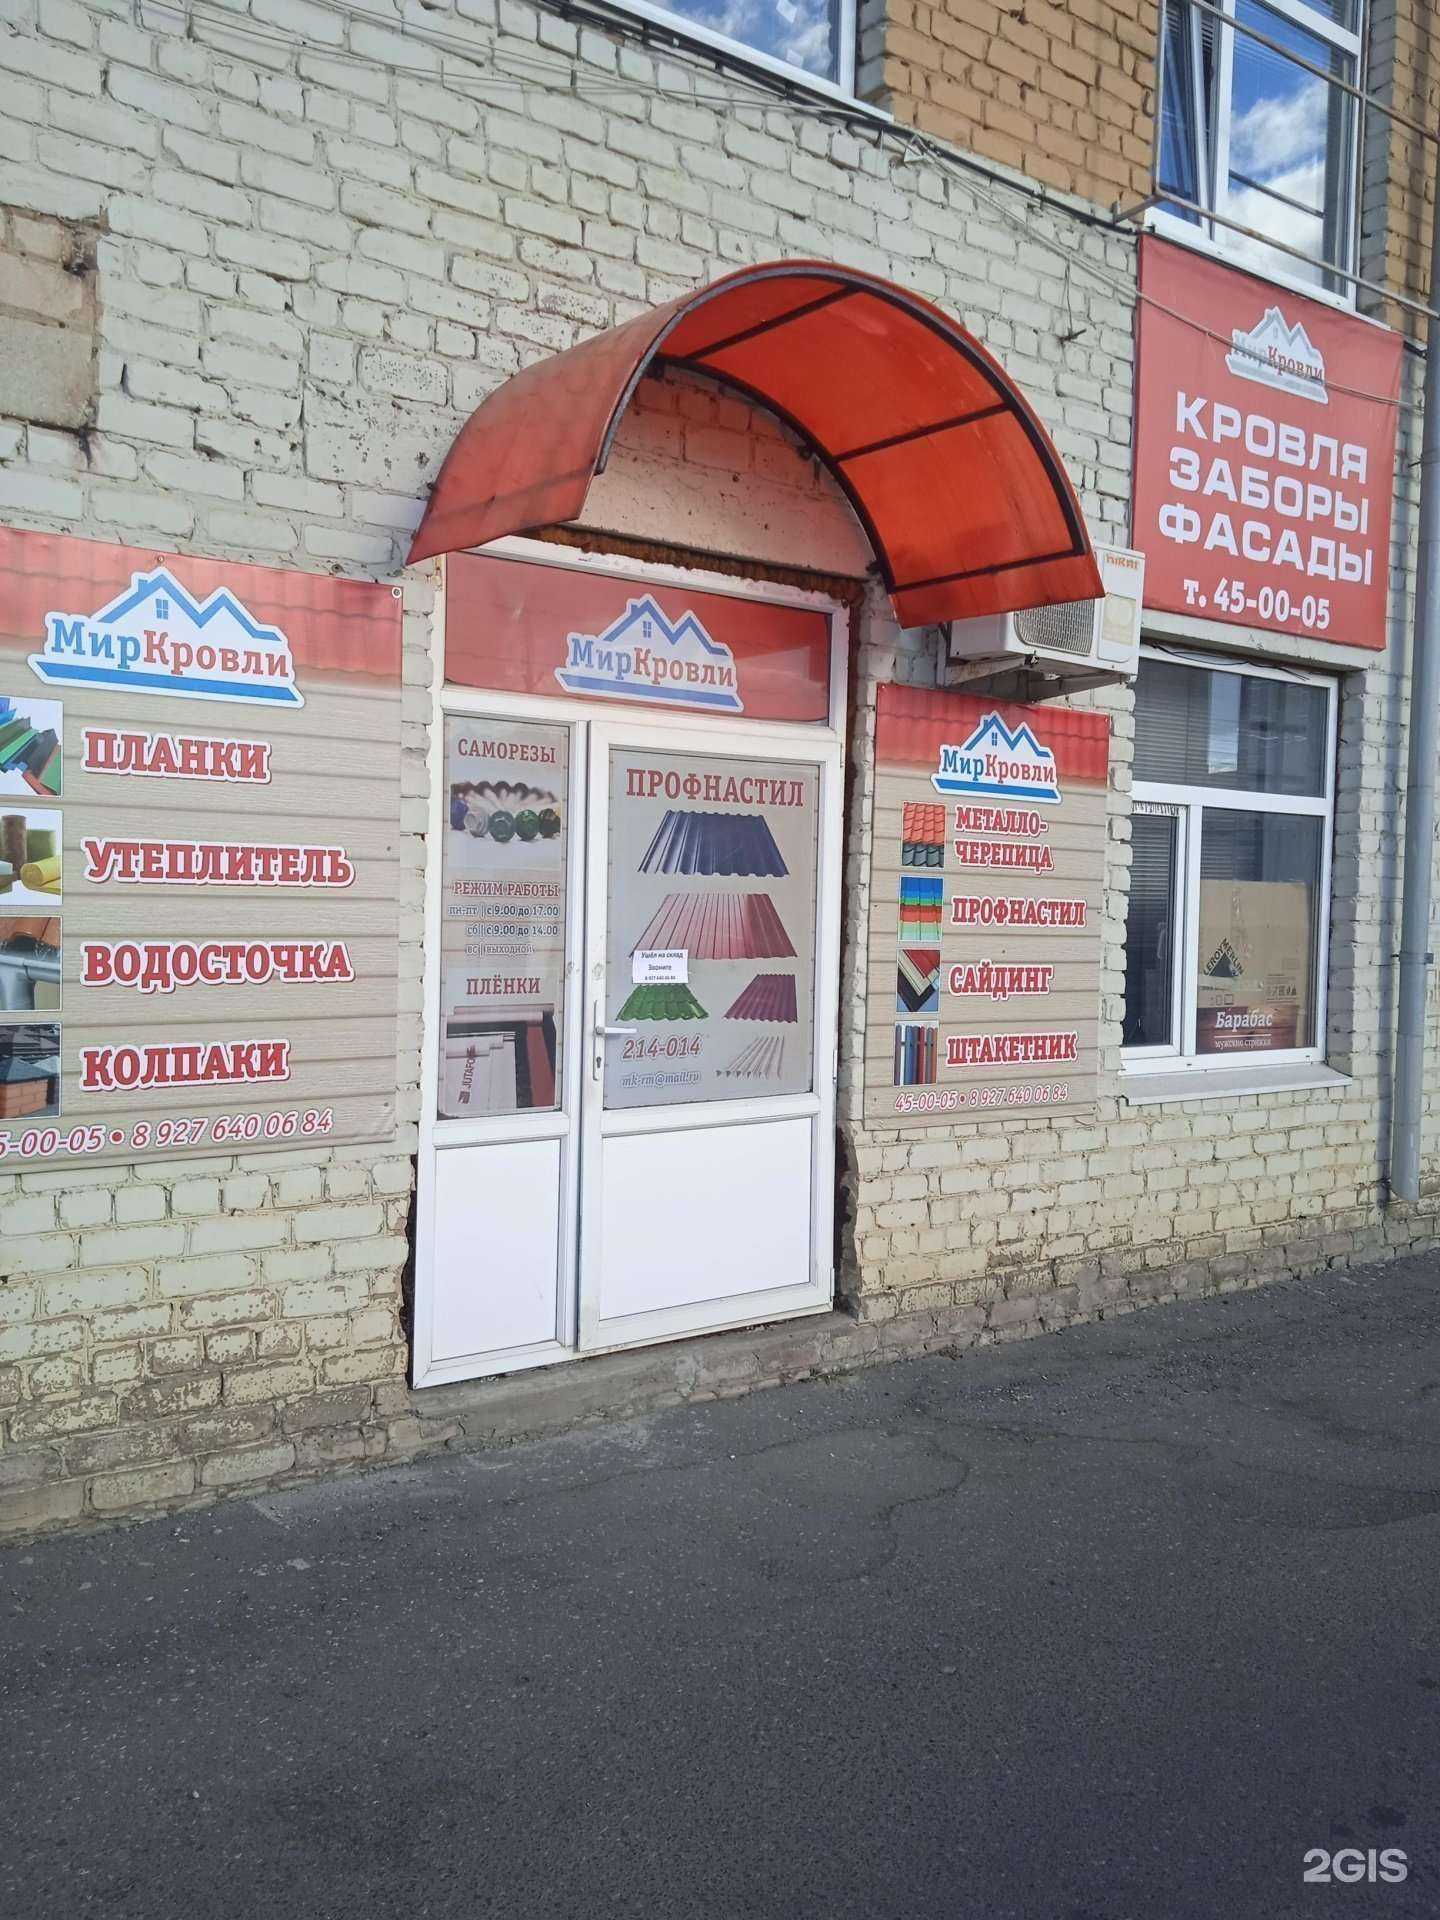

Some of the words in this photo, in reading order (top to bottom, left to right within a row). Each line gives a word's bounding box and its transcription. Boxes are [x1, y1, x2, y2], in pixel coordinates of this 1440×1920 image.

[1176, 391, 1368, 483] КРОВЛЯ
[1169, 446, 1369, 534] ЗАБОРЫ
[1158, 502, 1372, 585] ФАСАДЫ
[1214, 577, 1330, 630] 45-00-05
[51, 618, 289, 678] МирКровли
[570, 637, 734, 687] МирКровли
[84, 731, 267, 778] ПЛАНКИ
[457, 738, 557, 764] САМОРЕЗЫ
[942, 748, 1055, 784] МирКровли
[626, 768, 804, 808] ПРОФНАСТИЛ
[955, 806, 1048, 836] МЕТАЛЛО-
[85, 840, 352, 884] УТЕПЛИТЕЛЬ
[955, 841, 1053, 871] ЧЕРЕПИЦА
[454, 881, 503, 896] РЕЖИМ
[507, 883, 560, 897] РАБОТЫ
[517, 907, 530, 916] до
[532, 905, 559, 916] 17.00
[952, 898, 1086, 927] ПРОФНАСТИЛ
[517, 927, 529, 937] до
[532, 925, 559, 935] 14.00
[84, 943, 351, 990] ВОДОСТОЧКА
[1203, 946, 1224, 976] LEROY
[1220, 938, 1245, 976] MERLIN
[466, 974, 541, 995] ПЛЁНКИ
[950, 961, 1053, 998] САЙДИНГ
[1215, 1008, 1273, 1032] Барабас
[82, 1042, 287, 1087] КОЛПАКИ
[622, 1036, 700, 1059] 214-014
[947, 1034, 1077, 1064] ШТАКЕТНИК
[895, 1092, 958, 1111] 45-00-05
[969, 1089, 977, 1105] 8
[981, 1088, 1005, 1105] 927
[1008, 1087, 1031, 1103] 640
[1034, 1086, 1049, 1102] 06
[1053, 1084, 1068, 1100] 84
[132, 1124, 149, 1147] 8
[157, 1119, 205, 1146] 927
[213, 1115, 260, 1141] 640
[265, 1112, 295, 1138] 06
[302, 1109, 332, 1134] 84
